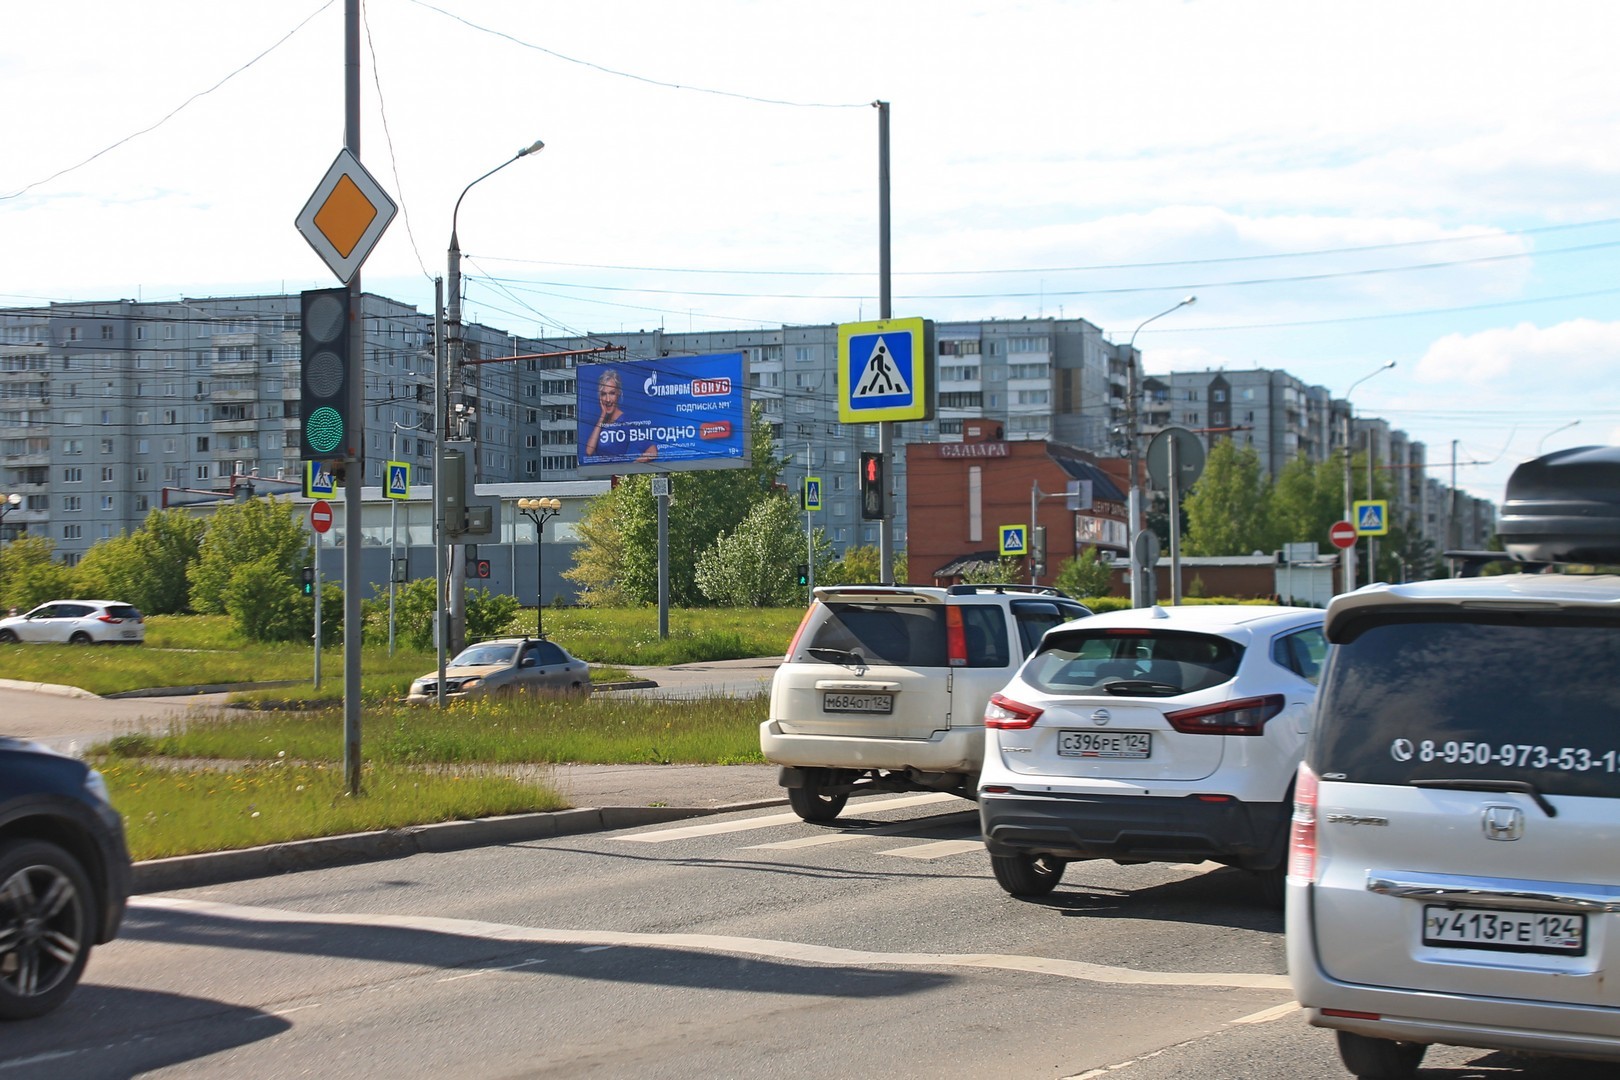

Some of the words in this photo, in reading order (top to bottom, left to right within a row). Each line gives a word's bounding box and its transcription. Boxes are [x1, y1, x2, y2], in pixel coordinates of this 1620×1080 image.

[657, 383, 690, 396] ГАЗПРОМ
[694, 381, 729, 394] БОНУС
[676, 402, 718, 412] ПОДПИСКА
[600, 429, 626, 443] ЭТО
[629, 425, 696, 442] ВЫГОДНО
[703, 426, 726, 437] узнать
[942, 443, 1006, 457] САМАРА
[1419, 740, 1620, 773] 8-950-973-53-1
[1435, 913, 1532, 942] У413РЕ
[1538, 916, 1577, 937] 124
